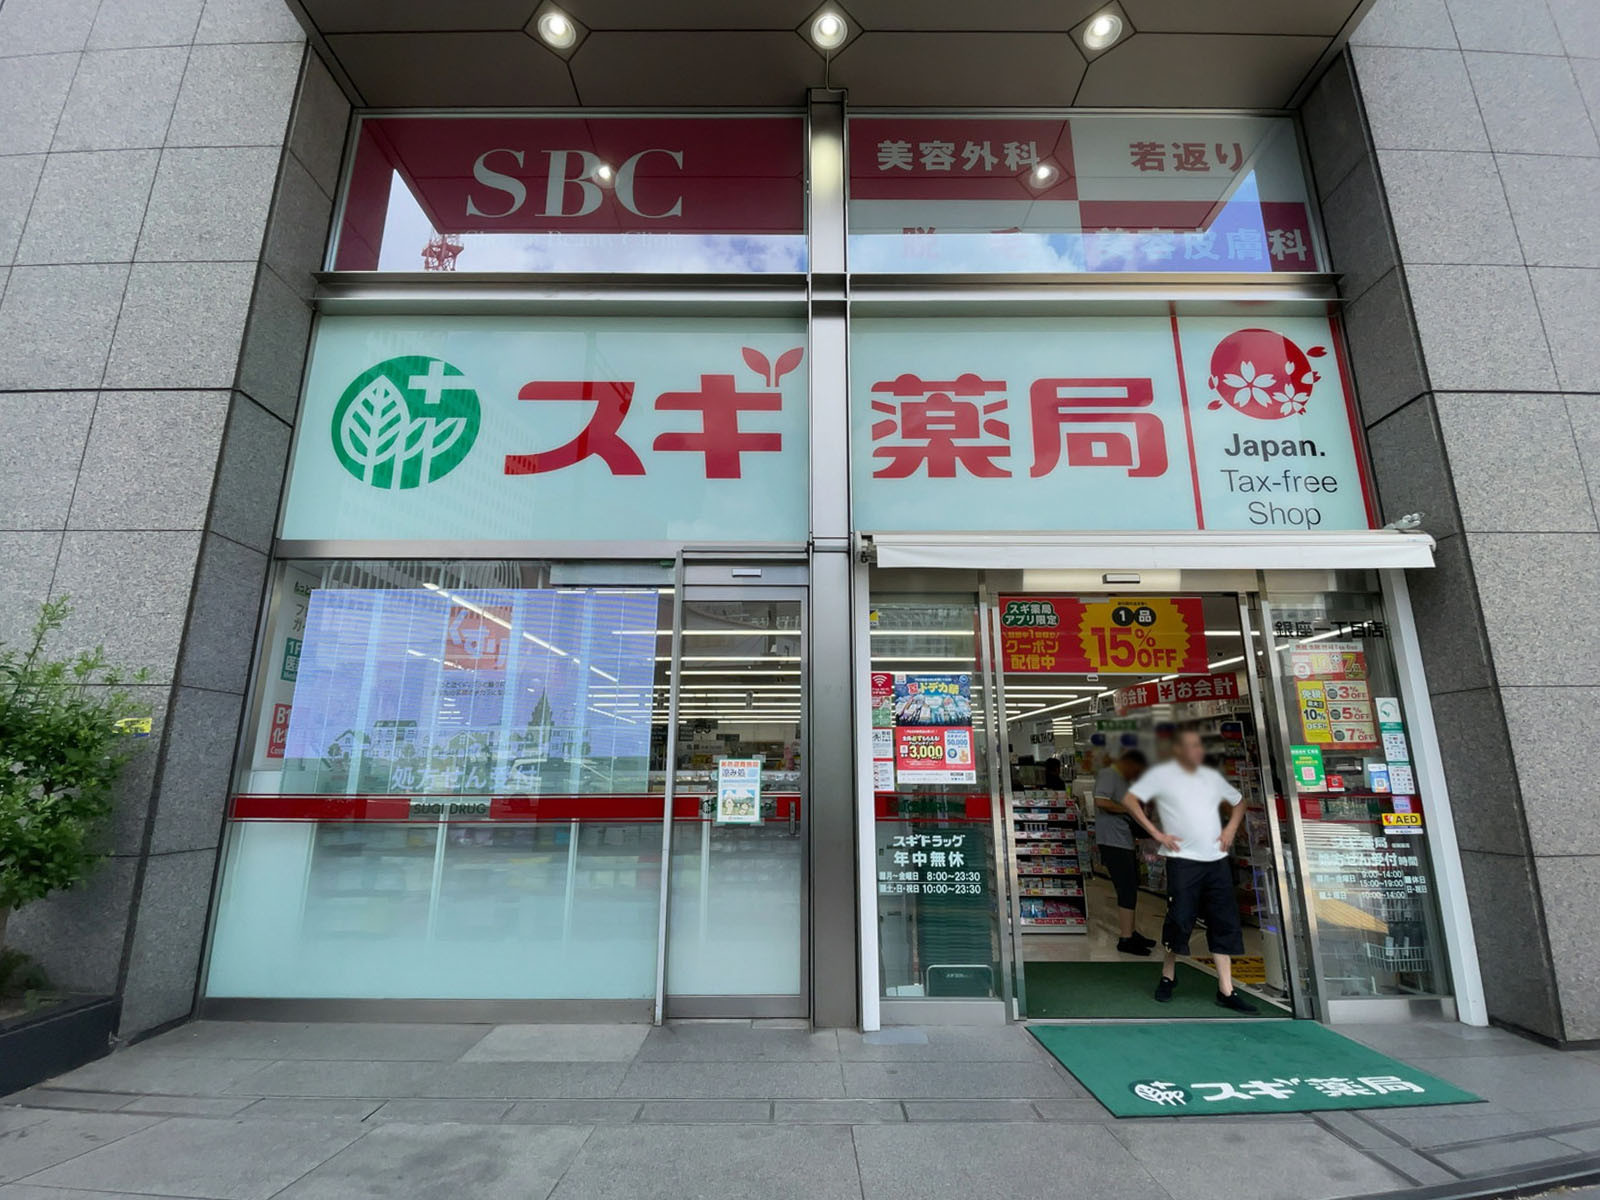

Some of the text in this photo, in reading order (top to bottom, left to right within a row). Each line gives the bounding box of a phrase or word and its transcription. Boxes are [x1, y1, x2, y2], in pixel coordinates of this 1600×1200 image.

[877, 140, 1040, 171] 美容外科
[1129, 142, 1244, 172] 若返り
[466, 149, 683, 218] SBC
[1224, 433, 1326, 459] Japan.
[1220, 468, 1338, 493] Tax-free
[1247, 501, 1322, 530] Shop
[1010, 604, 1052, 614] スギ薬局
[1005, 615, 1057, 625] アプリ限定
[1006, 640, 1059, 653] クーポン
[1010, 654, 1056, 670] 配信中
[1177, 677, 1233, 698] お会計
[908, 745, 943, 760] 3,000
[412, 803, 487, 814] SUGI DRUG
[1395, 815, 1418, 824] AED
[892, 833, 965, 848] スギドラッグ
[893, 851, 964, 868] 年中無休
[1190, 1075, 1426, 1102] スギ薬局
